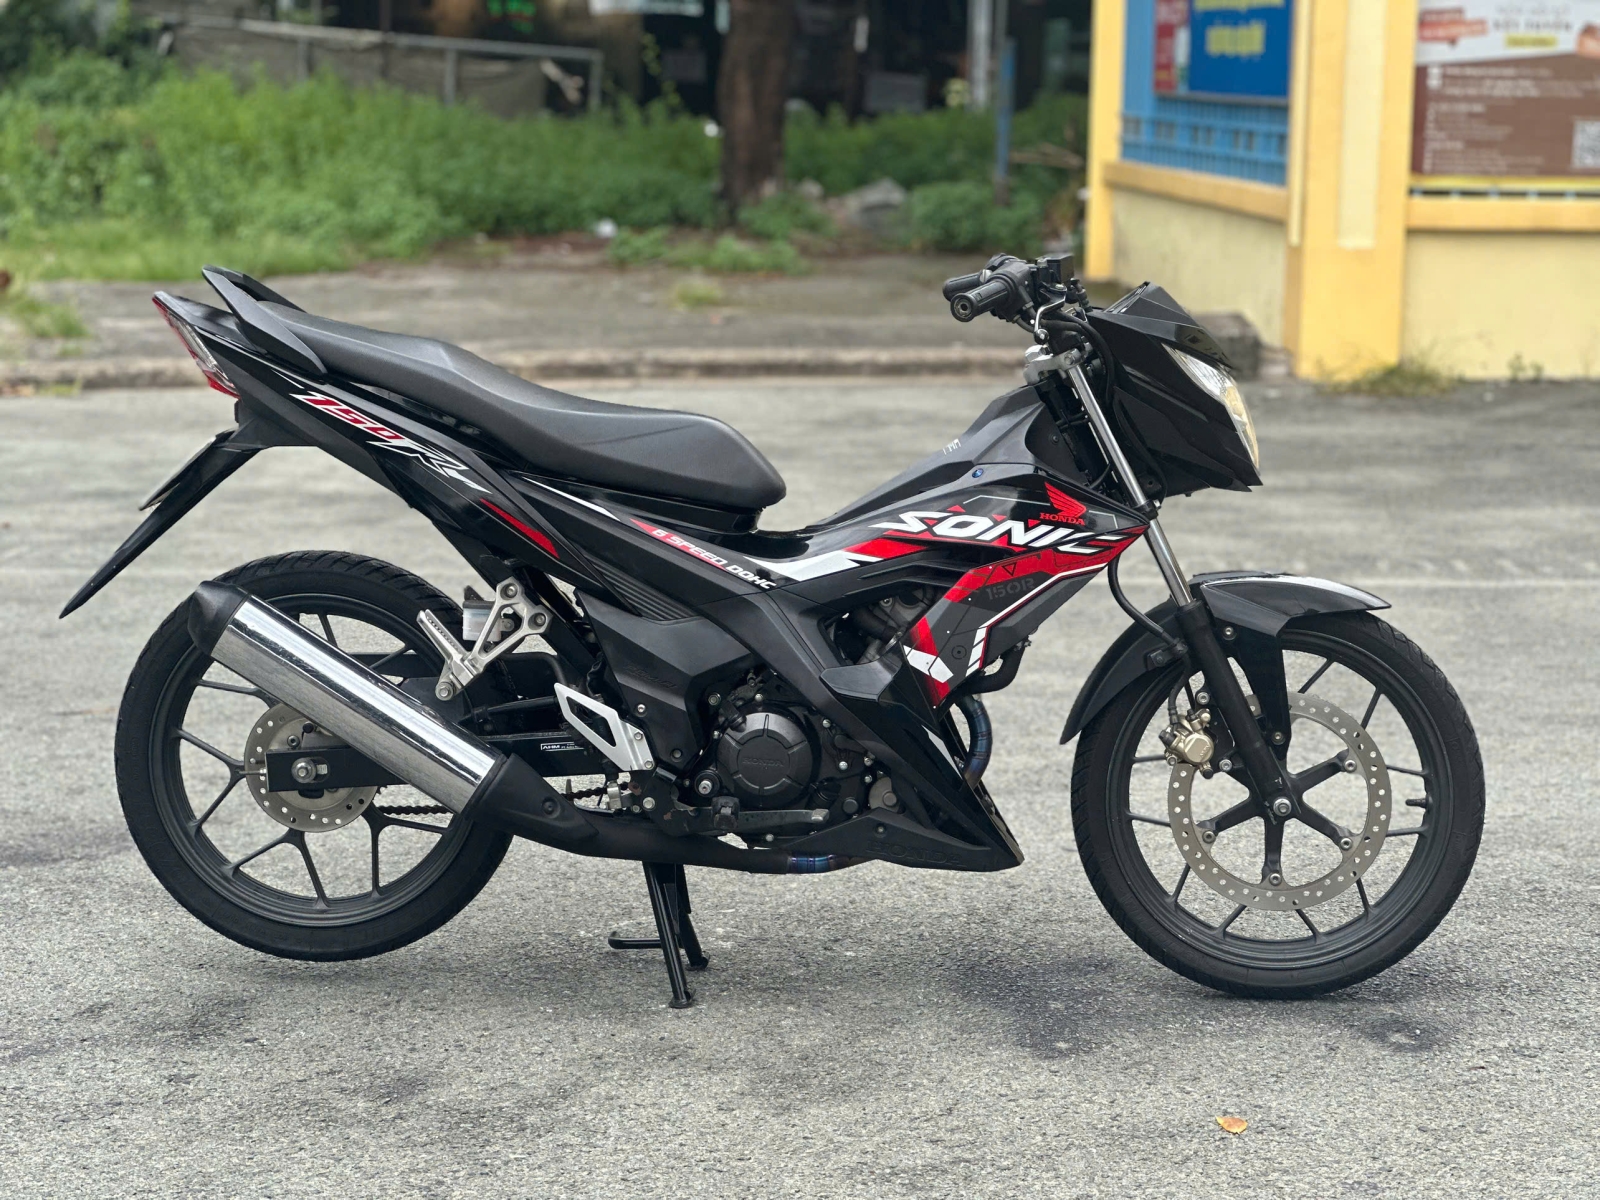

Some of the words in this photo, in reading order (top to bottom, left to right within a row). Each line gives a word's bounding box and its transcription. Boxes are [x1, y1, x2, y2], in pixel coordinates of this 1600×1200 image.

[868, 510, 1128, 554] SONIC
[1039, 512, 1086, 526] HONDA
[651, 528, 668, 537] 6
[666, 535, 730, 566] SPEED
[726, 564, 778, 590] DOHC
[741, 756, 785, 769] HONDA
[864, 840, 968, 868] HONDA
